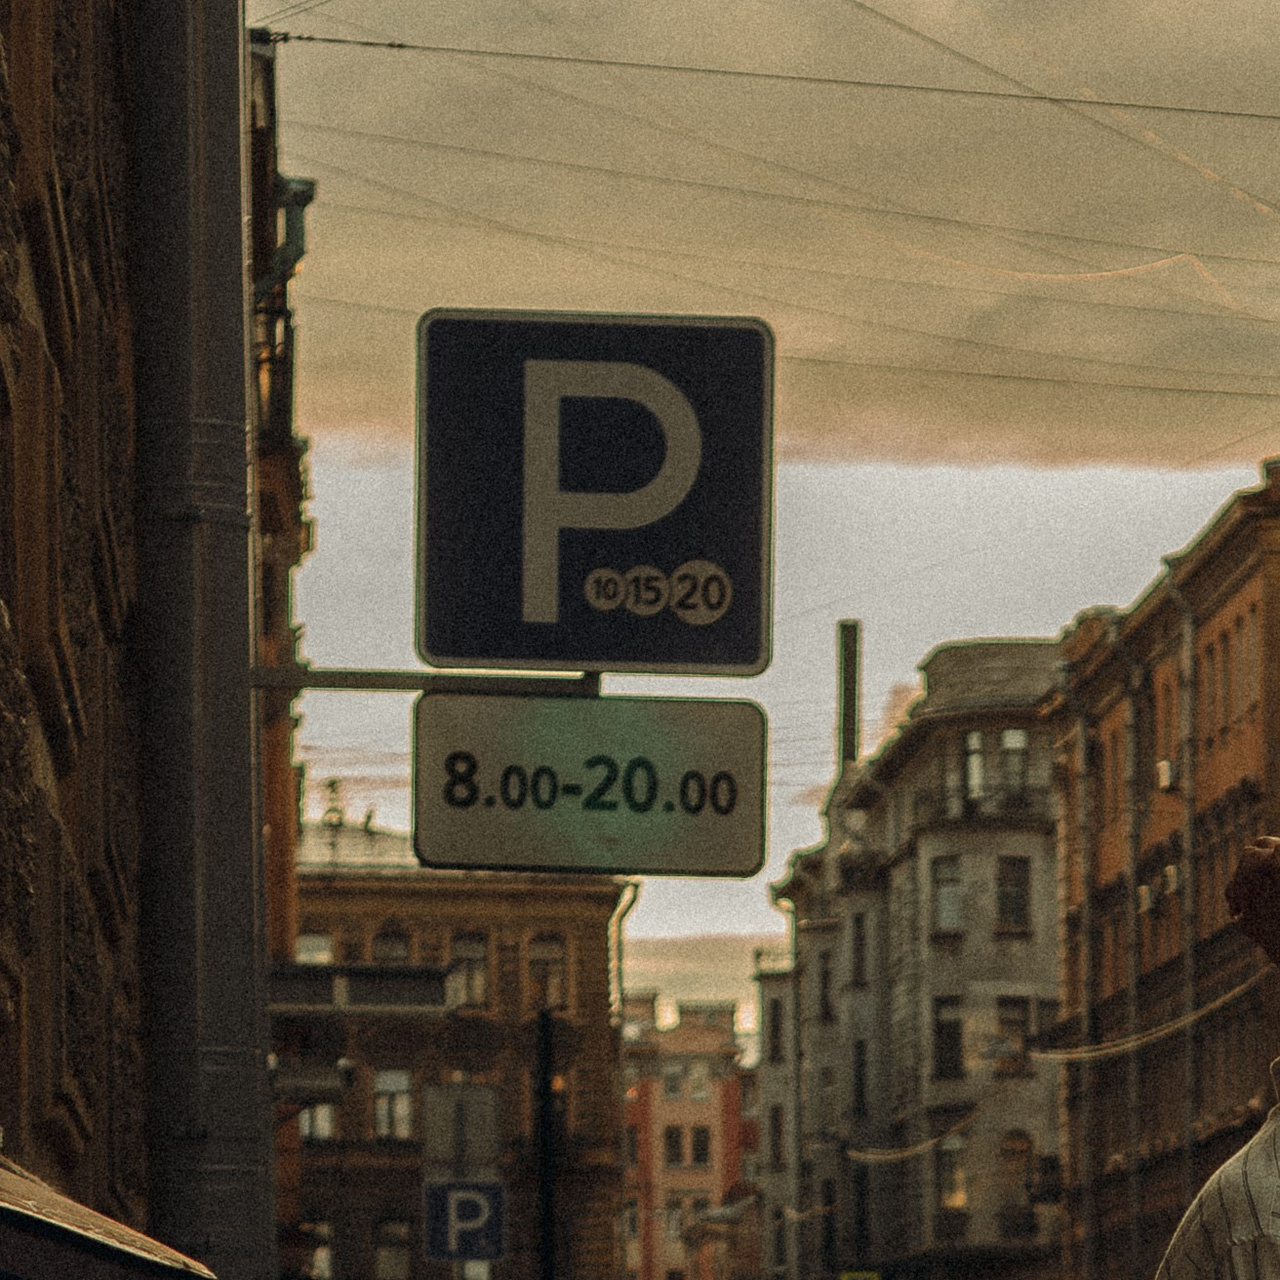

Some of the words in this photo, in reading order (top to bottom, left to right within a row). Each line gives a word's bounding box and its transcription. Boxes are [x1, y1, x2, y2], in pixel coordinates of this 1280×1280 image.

[523, 360, 702, 623] P
[593, 576, 619, 601] 10
[630, 575, 662, 605] 15
[676, 573, 726, 610] 20
[443, 751, 738, 815] 8.00-20.00
[448, 1190, 489, 1251] P
